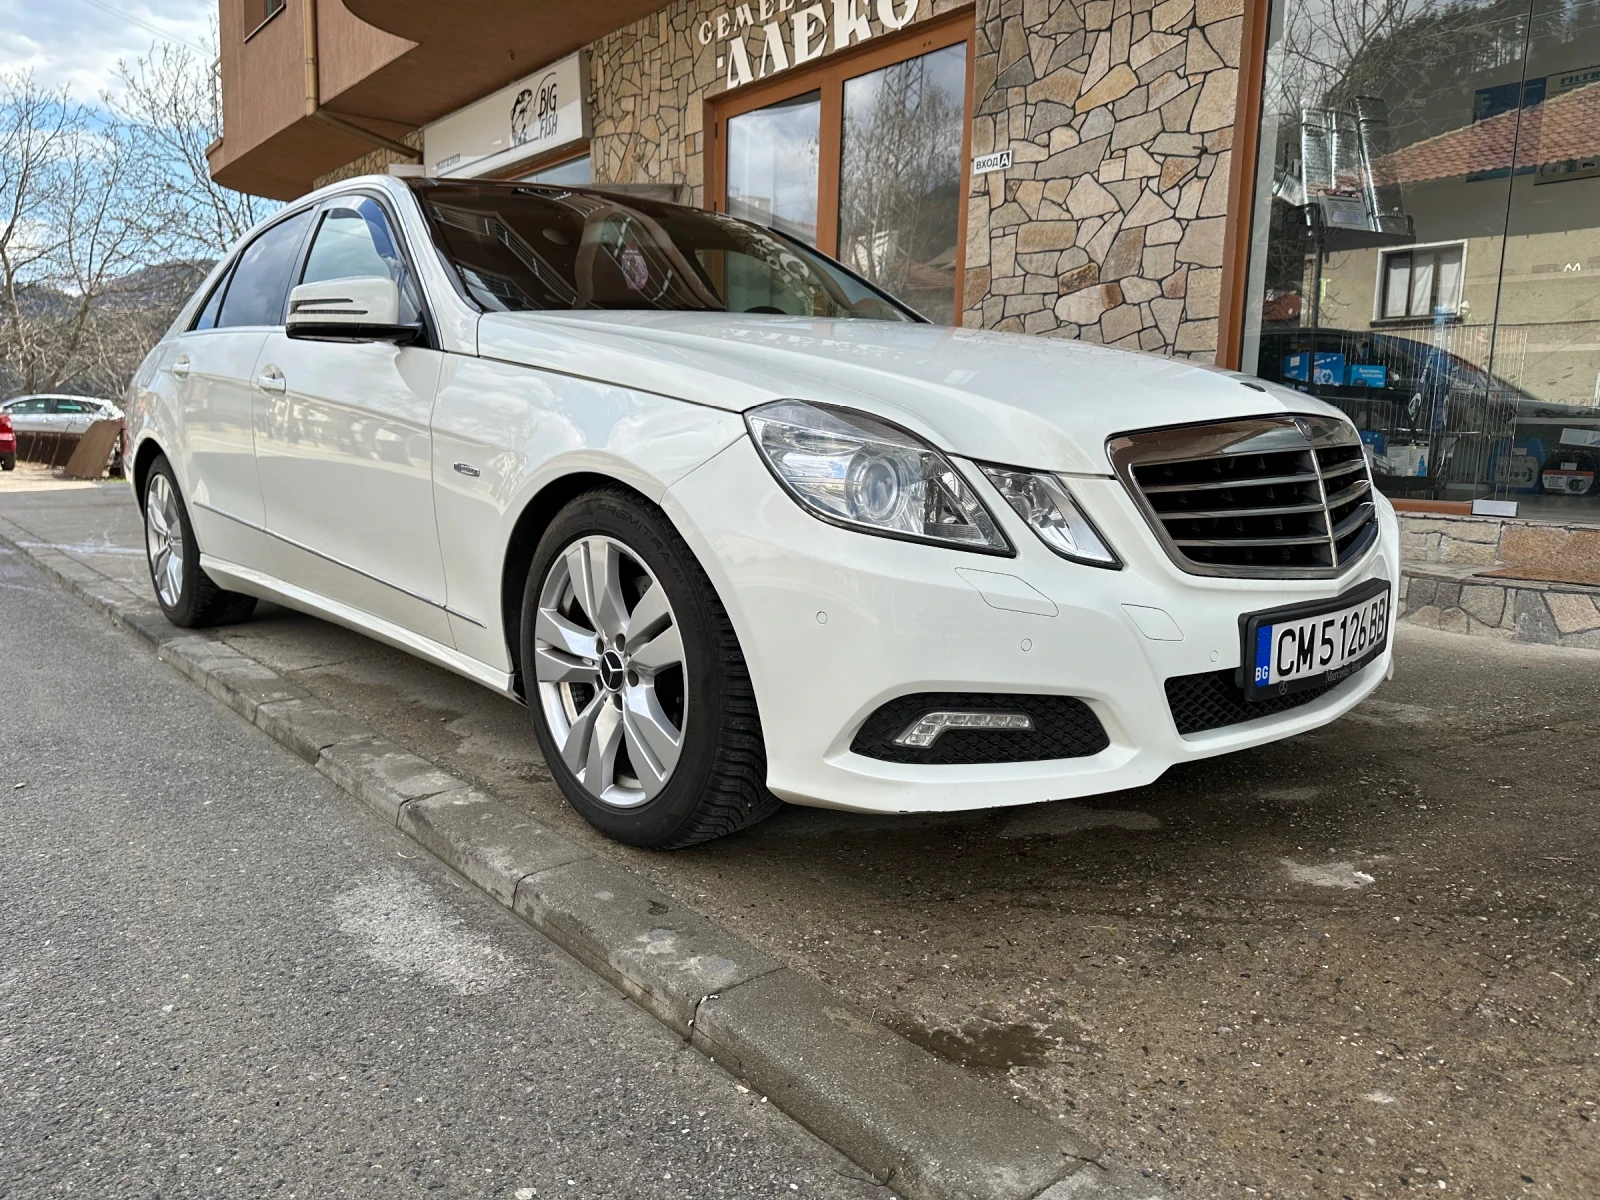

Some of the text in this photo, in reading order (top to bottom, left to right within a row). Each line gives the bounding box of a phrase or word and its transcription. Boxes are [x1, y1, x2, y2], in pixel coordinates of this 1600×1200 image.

[538, 83, 557, 118] BIG
[539, 114, 558, 139] FISH
[976, 157, 999, 170] ВХОД
[596, 503, 671, 564] PREMITRA
[1255, 665, 1269, 681] BG
